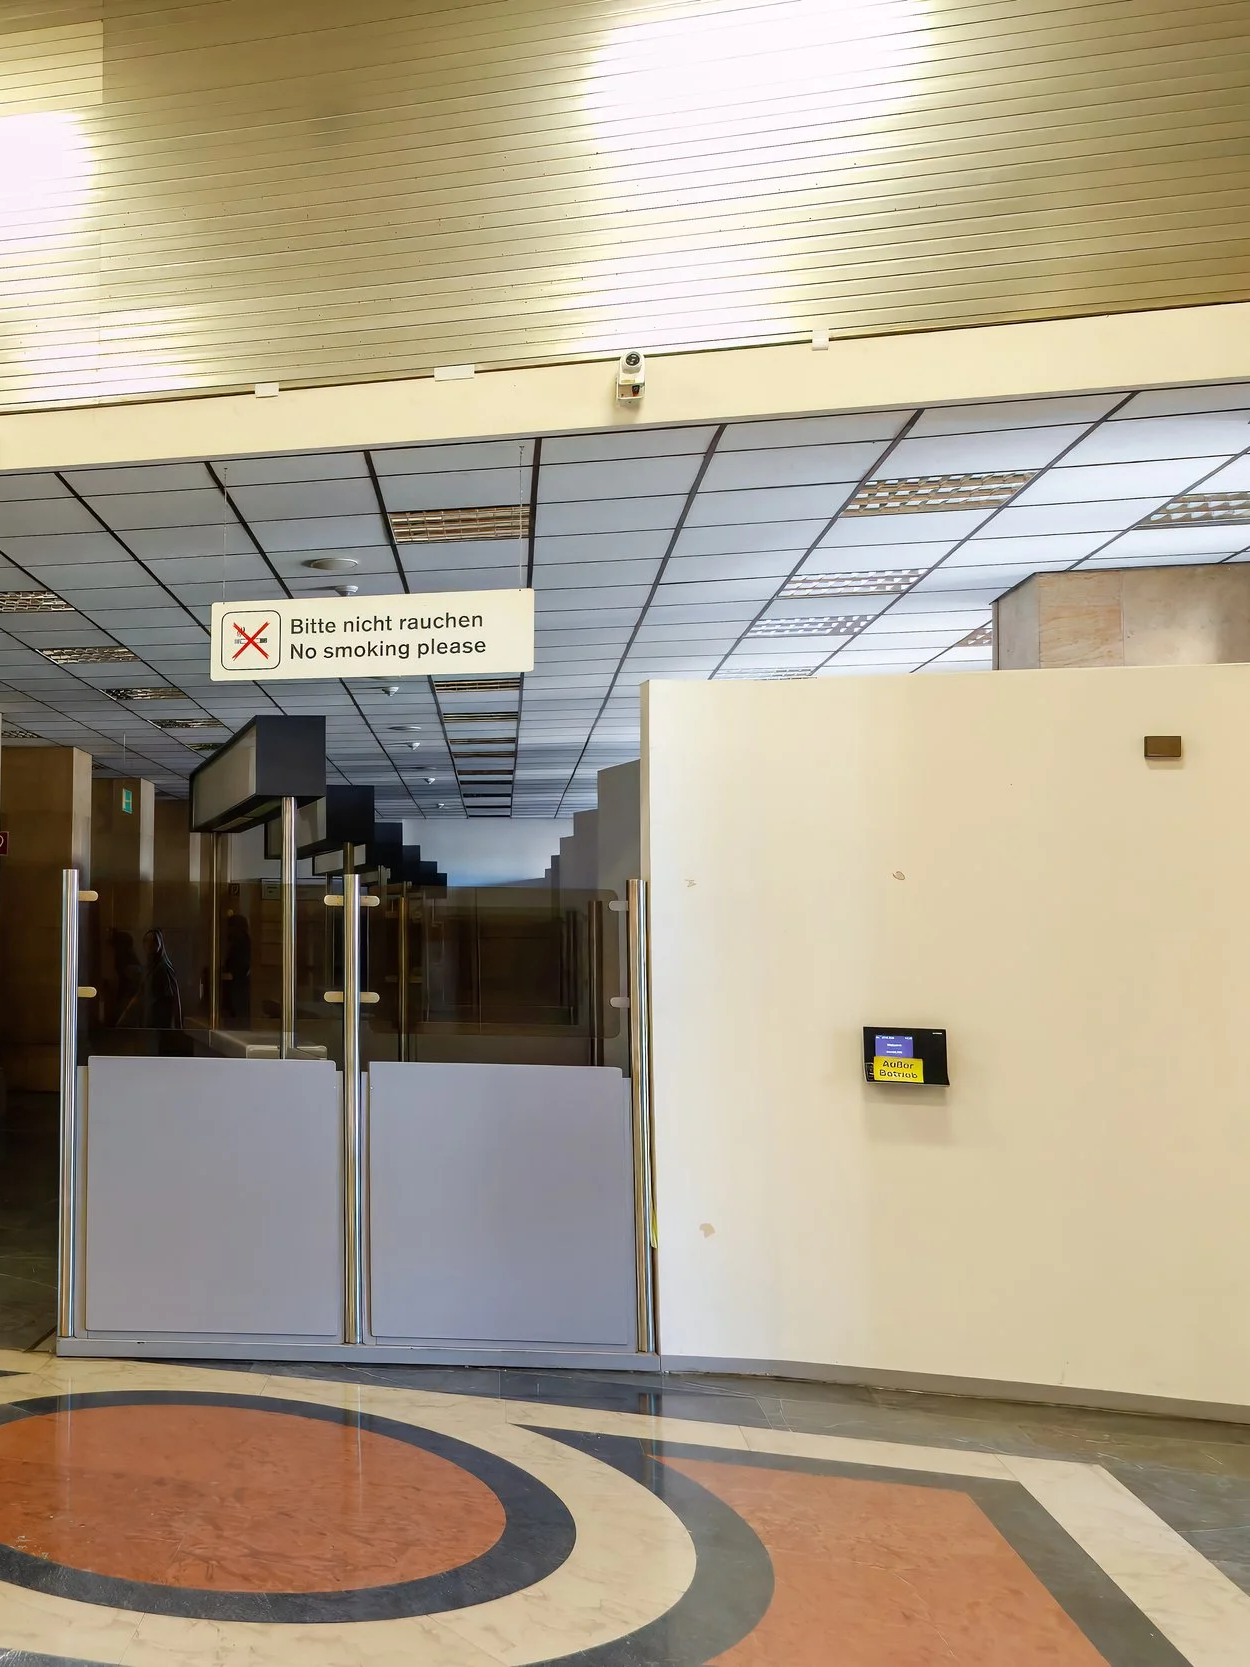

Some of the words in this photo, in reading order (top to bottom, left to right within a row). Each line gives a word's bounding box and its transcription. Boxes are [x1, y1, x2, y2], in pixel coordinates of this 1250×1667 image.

[290, 618, 337, 634] Bitte
[343, 615, 393, 632] nicht
[399, 613, 483, 630] rauchen
[290, 643, 317, 660] No
[323, 640, 411, 659] smoking
[417, 638, 487, 658] please
